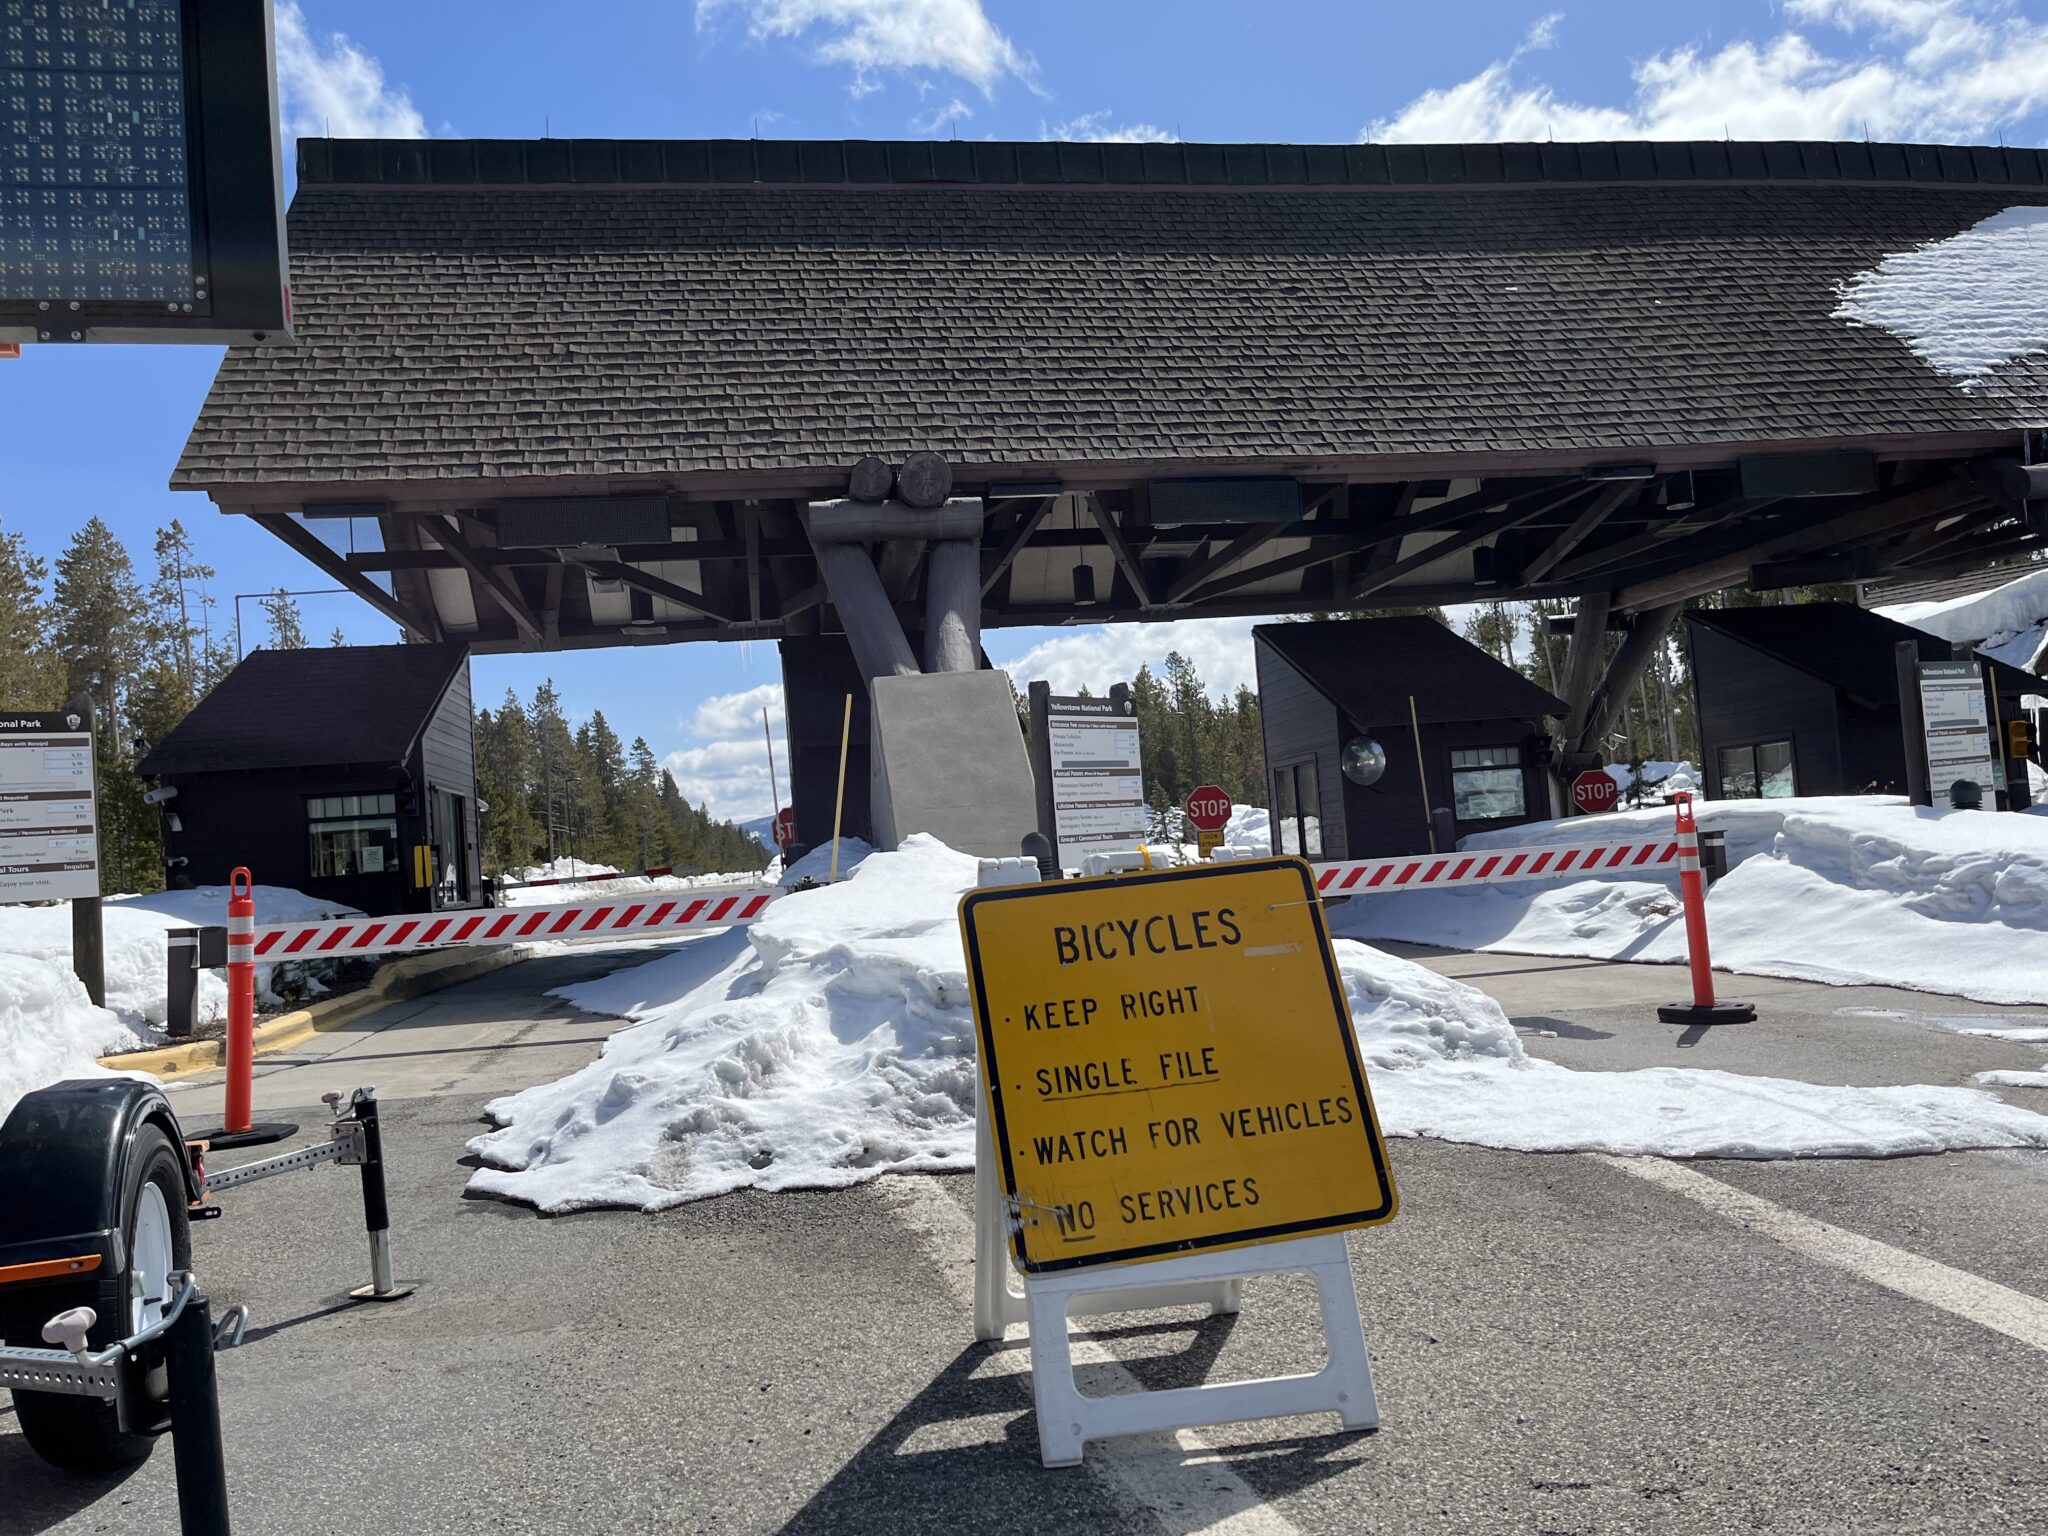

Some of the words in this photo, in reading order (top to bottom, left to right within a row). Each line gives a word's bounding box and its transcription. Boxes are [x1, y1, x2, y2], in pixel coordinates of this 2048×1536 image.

[1050, 703, 1080, 711] Yellowstone
[1081, 704, 1101, 712] National
[20, 719, 42, 728] Park
[1576, 782, 1615, 801] STOP
[1190, 800, 1228, 818] STOP
[775, 822, 793, 840] ST
[63, 863, 90, 871] Inquire
[1053, 908, 1242, 965] BICYCLES
[1023, 998, 1098, 1031] KEEP
[1121, 986, 1199, 1020] RIGHT
[1036, 1058, 1137, 1097] SINGLE
[1160, 1047, 1219, 1081] FILE
[1033, 1127, 1128, 1165] WATCH
[1148, 1118, 1200, 1149] FOR
[1220, 1097, 1352, 1138] VEHICLES
[1056, 1201, 1096, 1235] NO
[1121, 1178, 1260, 1224] SERVICES
